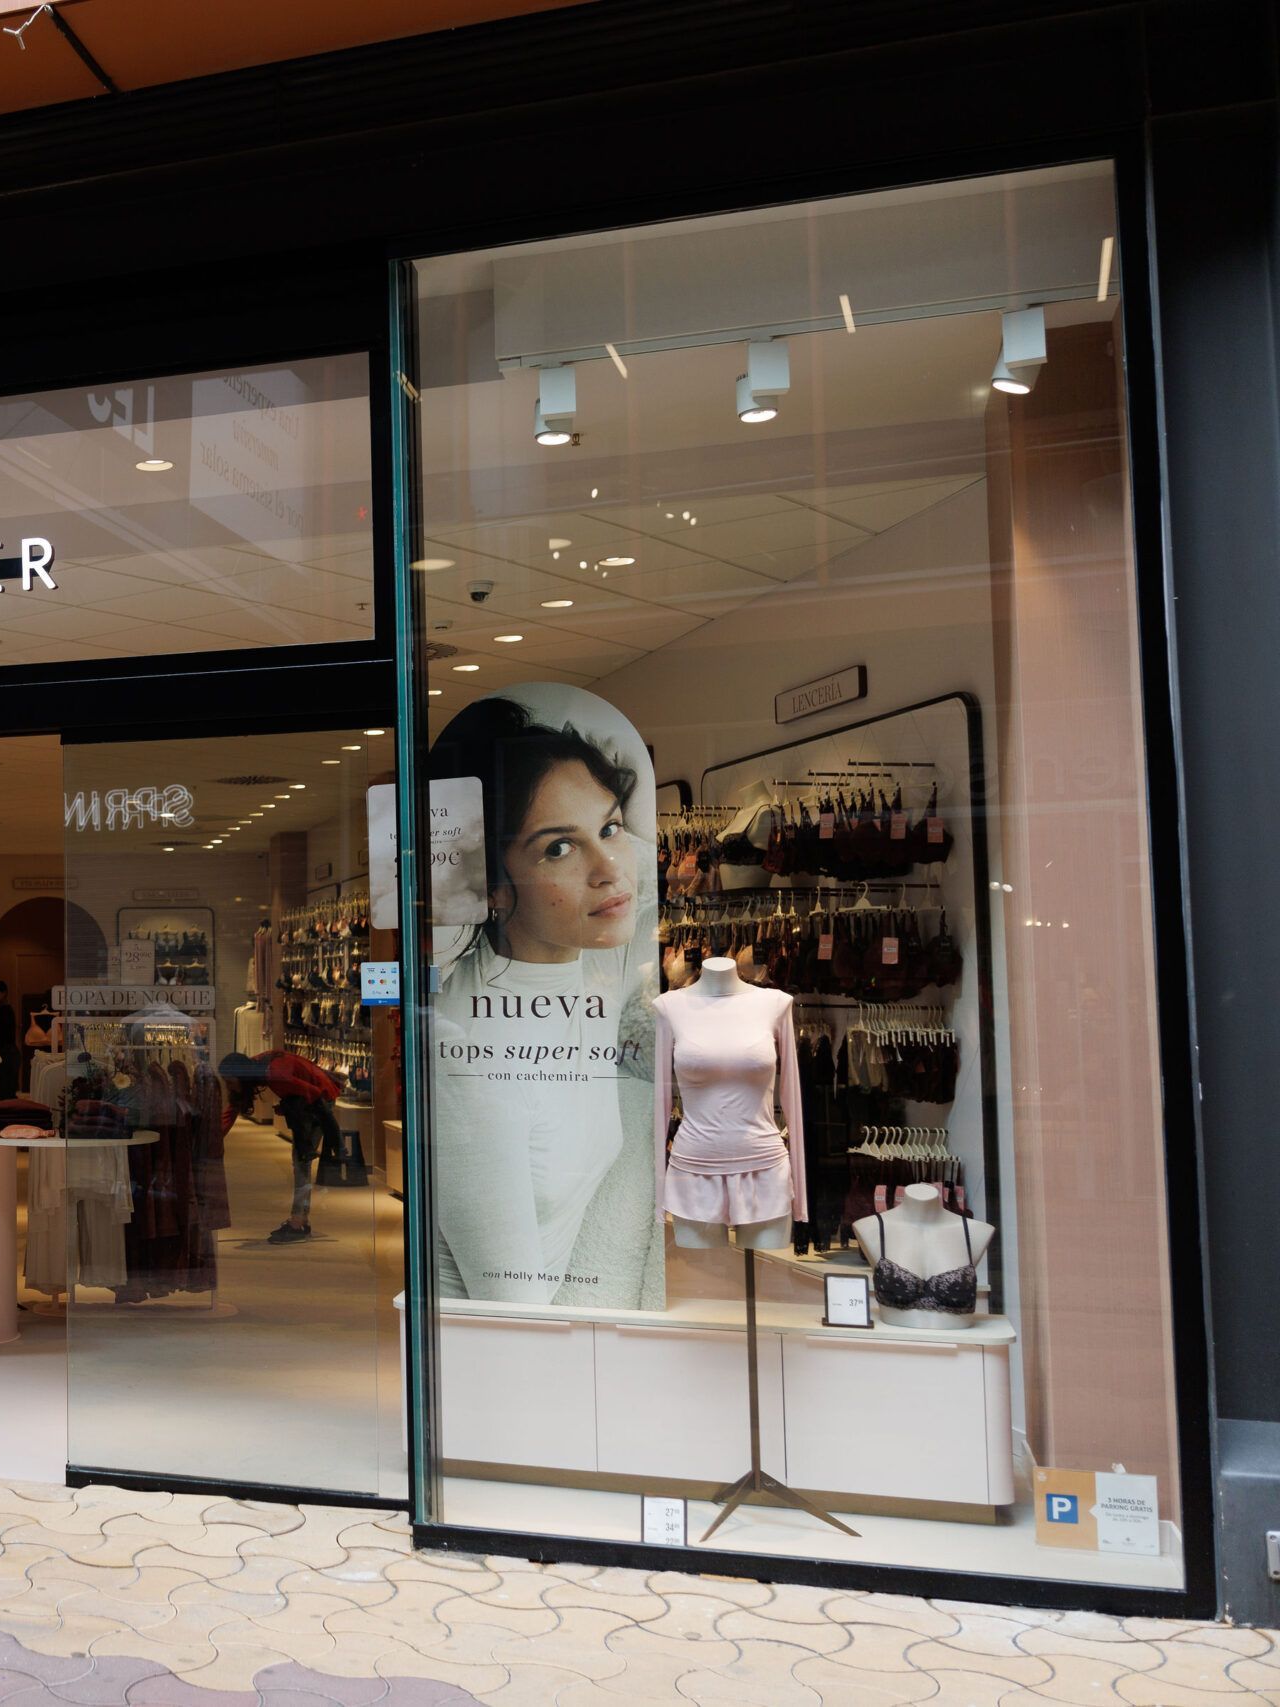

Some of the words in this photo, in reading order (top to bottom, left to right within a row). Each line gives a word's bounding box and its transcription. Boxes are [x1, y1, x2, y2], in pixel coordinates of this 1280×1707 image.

[792, 677, 842, 713] LENCERÍA
[111, 990, 137, 1006] DE
[141, 990, 211, 1006] NOCHE
[470, 994, 607, 1019] nueva
[438, 1041, 494, 1064] tops
[504, 1044, 580, 1065] super
[588, 1039, 642, 1066] soft
[487, 1071, 511, 1082] con
[516, 1070, 589, 1082] cachemira
[482, 1271, 500, 1279] con
[504, 1271, 533, 1282] Holly
[537, 1273, 560, 1282] Mae
[564, 1274, 599, 1284] Brood
[1052, 1497, 1072, 1520] P
[1101, 1503, 1129, 1511] PARKING
